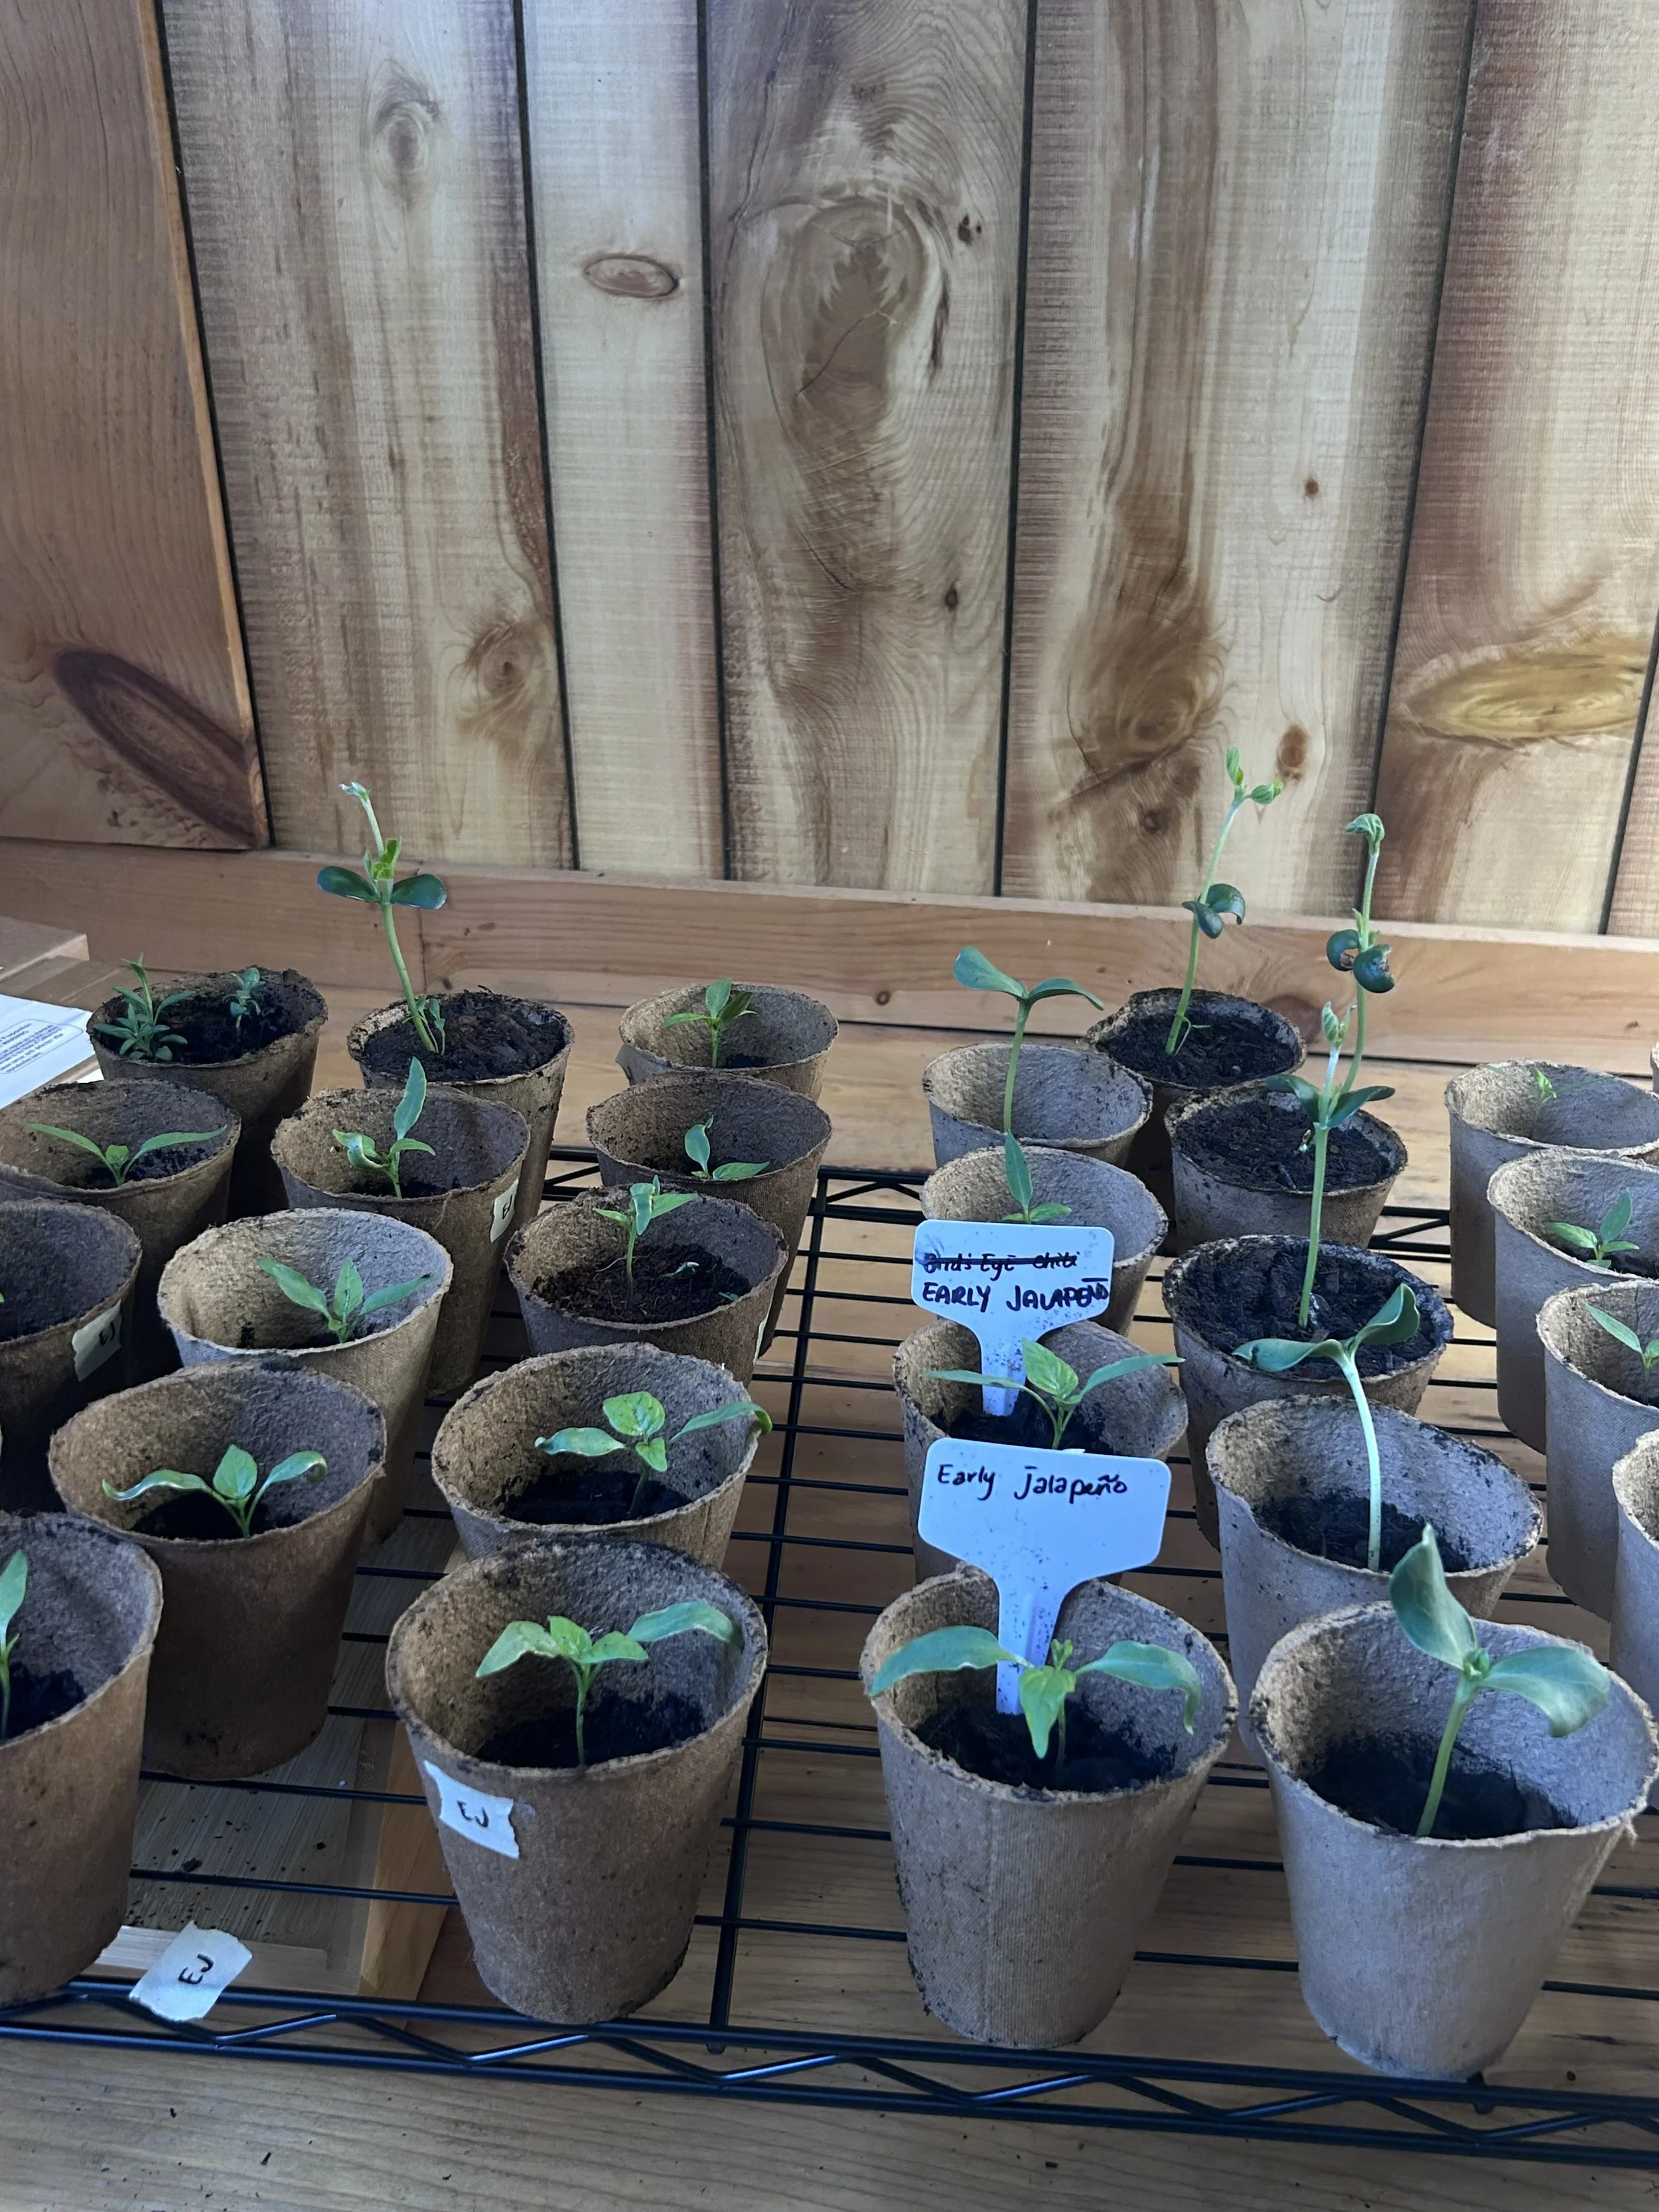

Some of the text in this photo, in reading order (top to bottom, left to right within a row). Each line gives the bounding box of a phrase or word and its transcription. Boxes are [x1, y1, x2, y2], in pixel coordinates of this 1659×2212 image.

[979, 1253, 1017, 1281] Eye
[922, 1282, 991, 1312] EARLY
[938, 1464, 1127, 1504] Early Jalapeño
[178, 1953, 214, 1984] EJ
